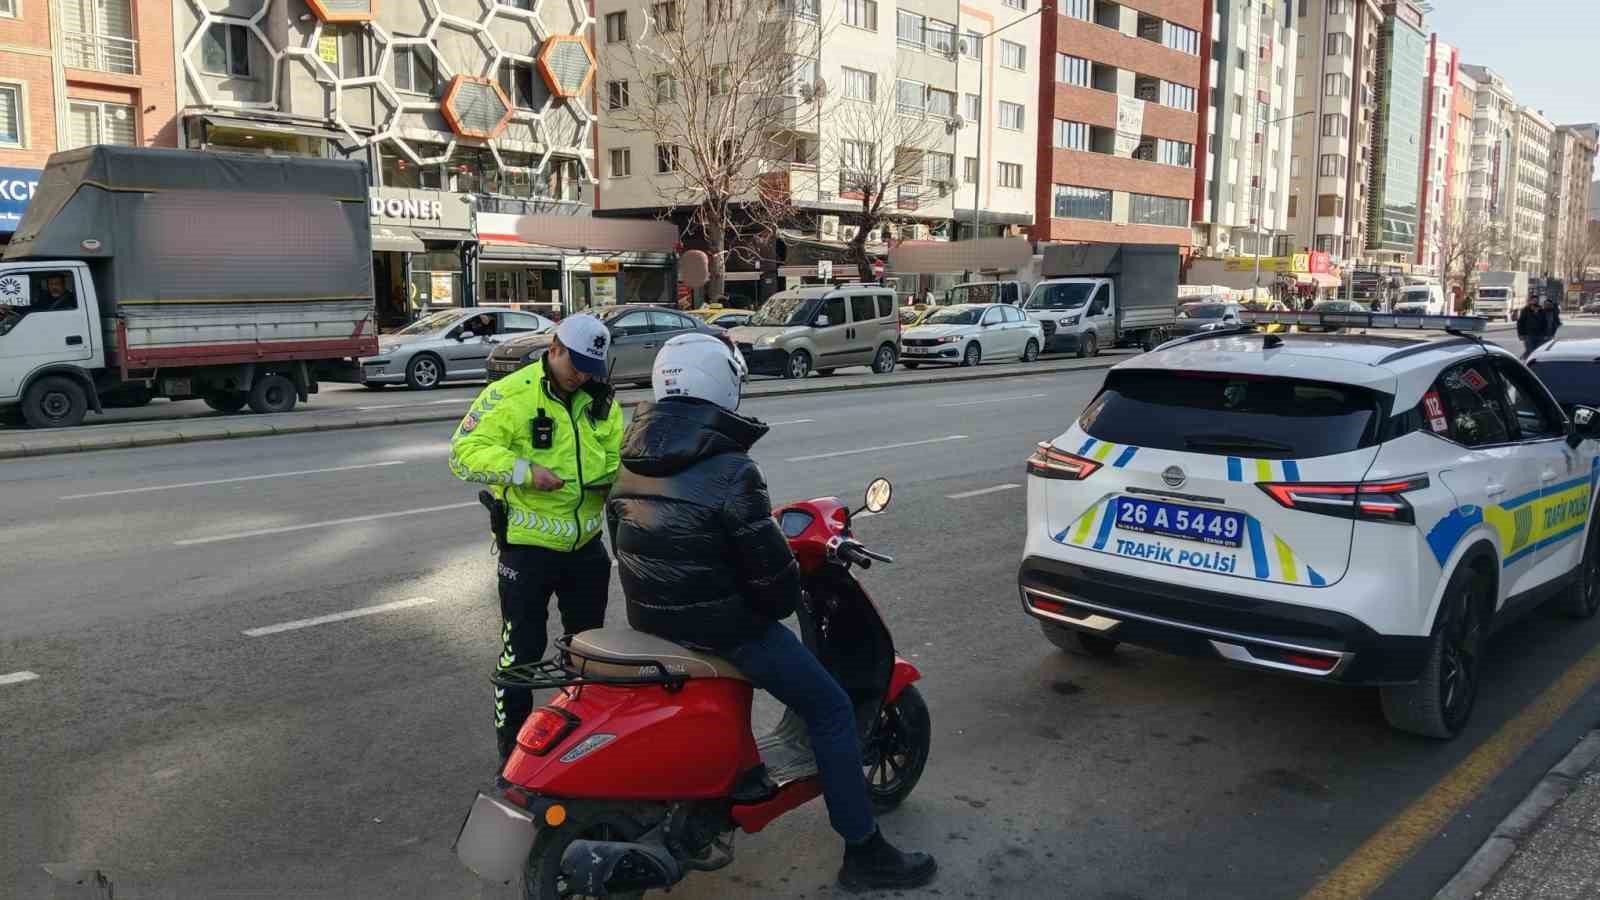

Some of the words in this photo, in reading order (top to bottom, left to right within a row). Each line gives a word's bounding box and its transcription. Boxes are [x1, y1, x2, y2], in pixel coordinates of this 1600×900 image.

[1425, 396, 1443, 417] 112
[1121, 502, 1148, 524] 26
[1153, 507, 1169, 528] A
[1176, 510, 1238, 538] 5449
[1116, 538, 1173, 562] TRAFİK
[1178, 549, 1236, 573] POLİSİ
